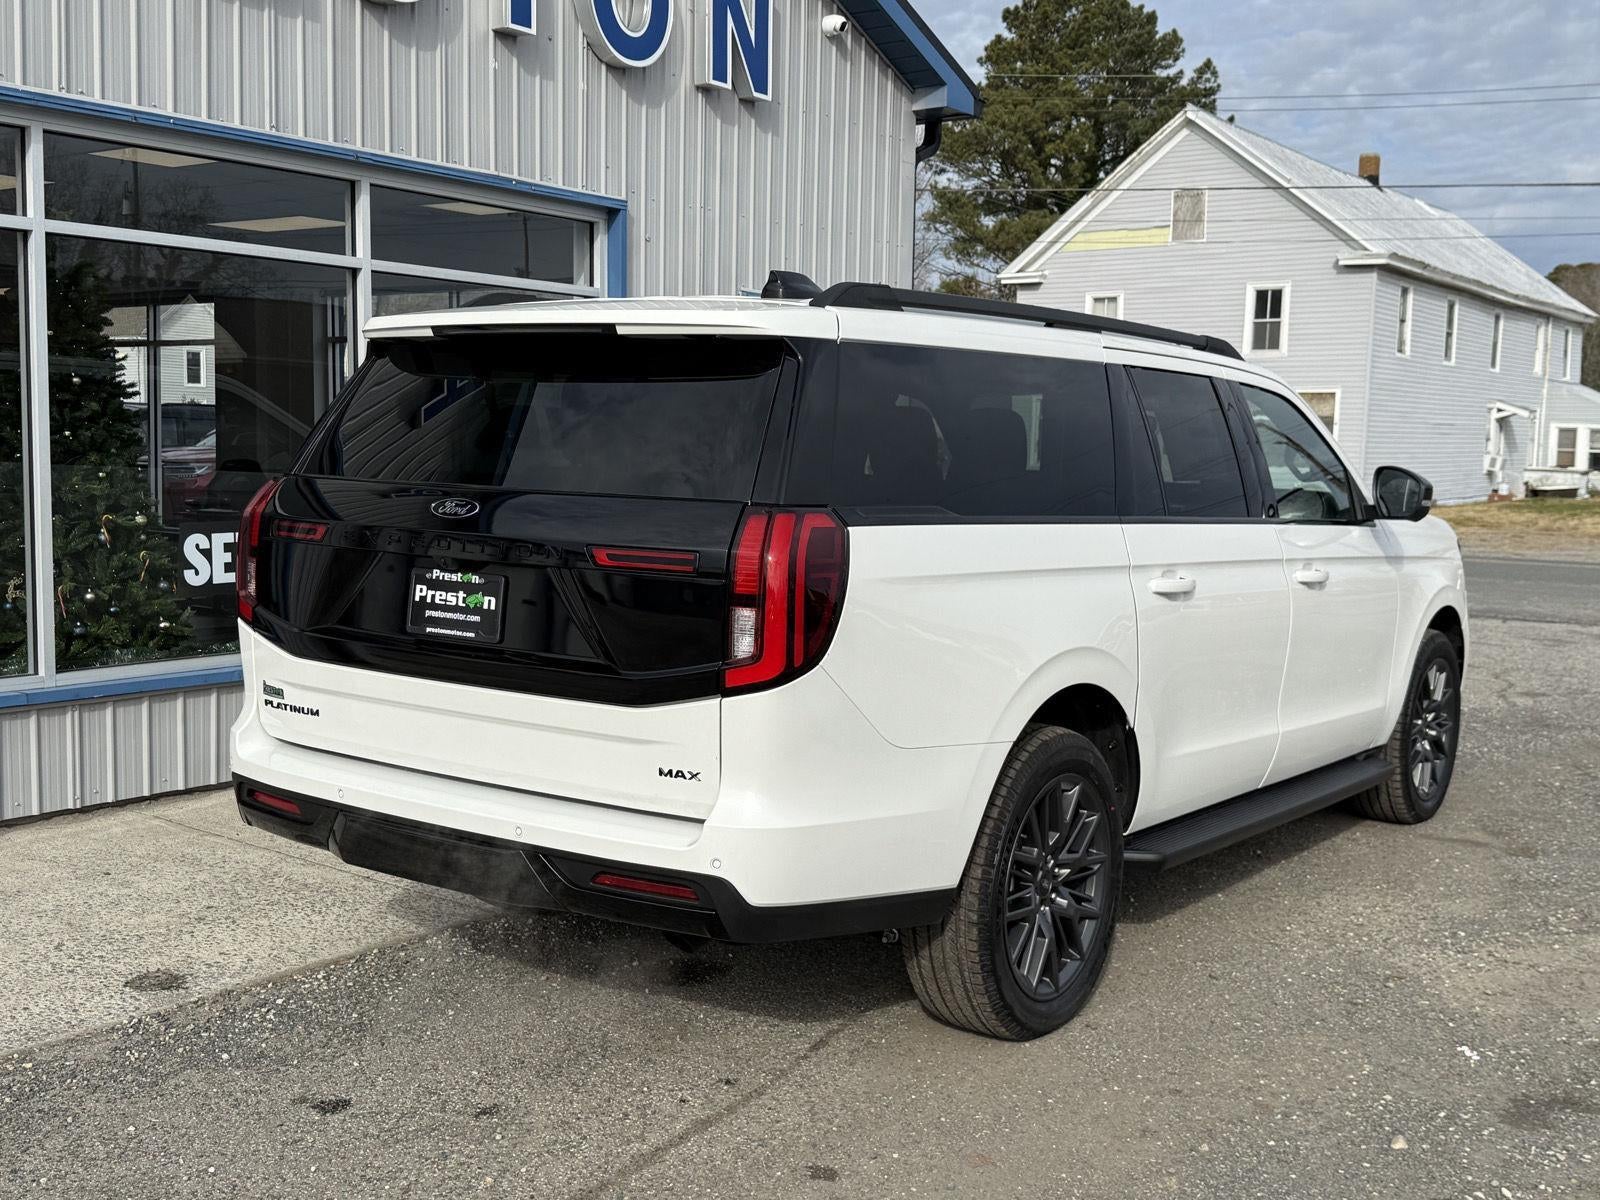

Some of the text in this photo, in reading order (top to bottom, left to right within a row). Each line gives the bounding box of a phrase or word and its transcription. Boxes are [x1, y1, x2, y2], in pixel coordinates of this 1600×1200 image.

[437, 500, 473, 516] Ford
[183, 532, 239, 587] SE
[432, 568, 480, 584] Preston
[414, 584, 496, 611] Preston
[425, 609, 481, 622] prestonmotor.com
[426, 626, 475, 638] prestonmotor.com
[264, 698, 320, 717] PLATINUM
[658, 766, 702, 782] MAX
